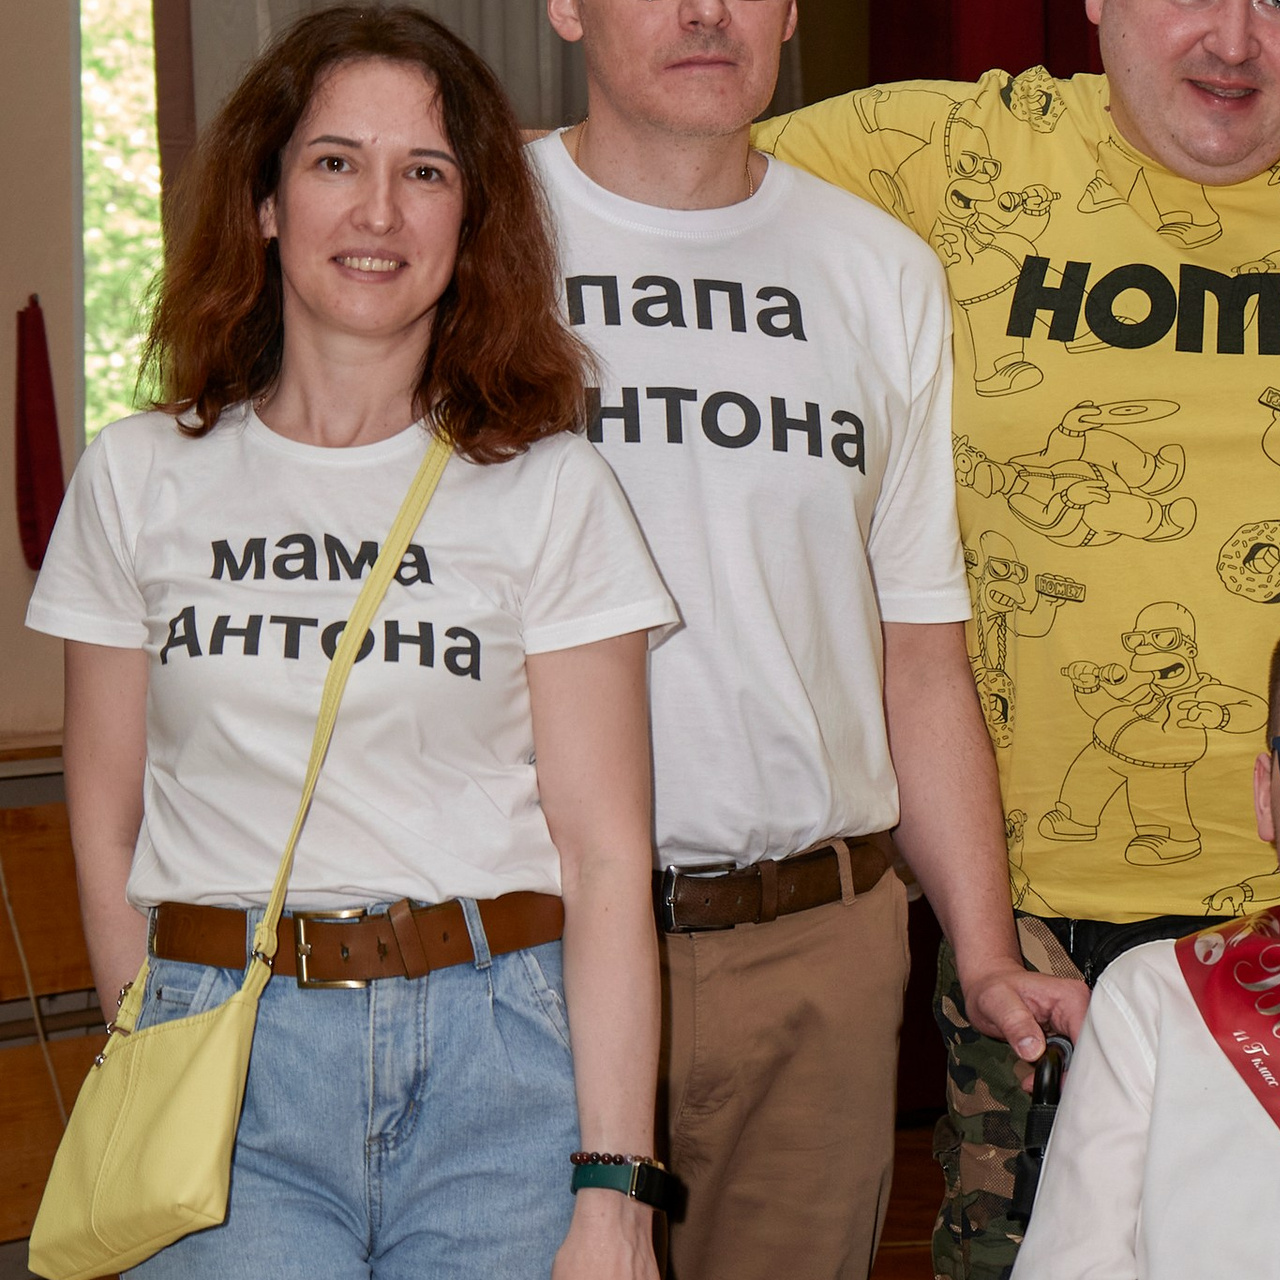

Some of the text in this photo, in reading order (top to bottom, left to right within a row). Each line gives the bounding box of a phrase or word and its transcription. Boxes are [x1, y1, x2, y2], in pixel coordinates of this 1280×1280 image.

[565, 274, 808, 342] папа
[584, 386, 866, 476] нтона
[210, 533, 434, 586] мама
[159, 605, 482, 681] Антона
